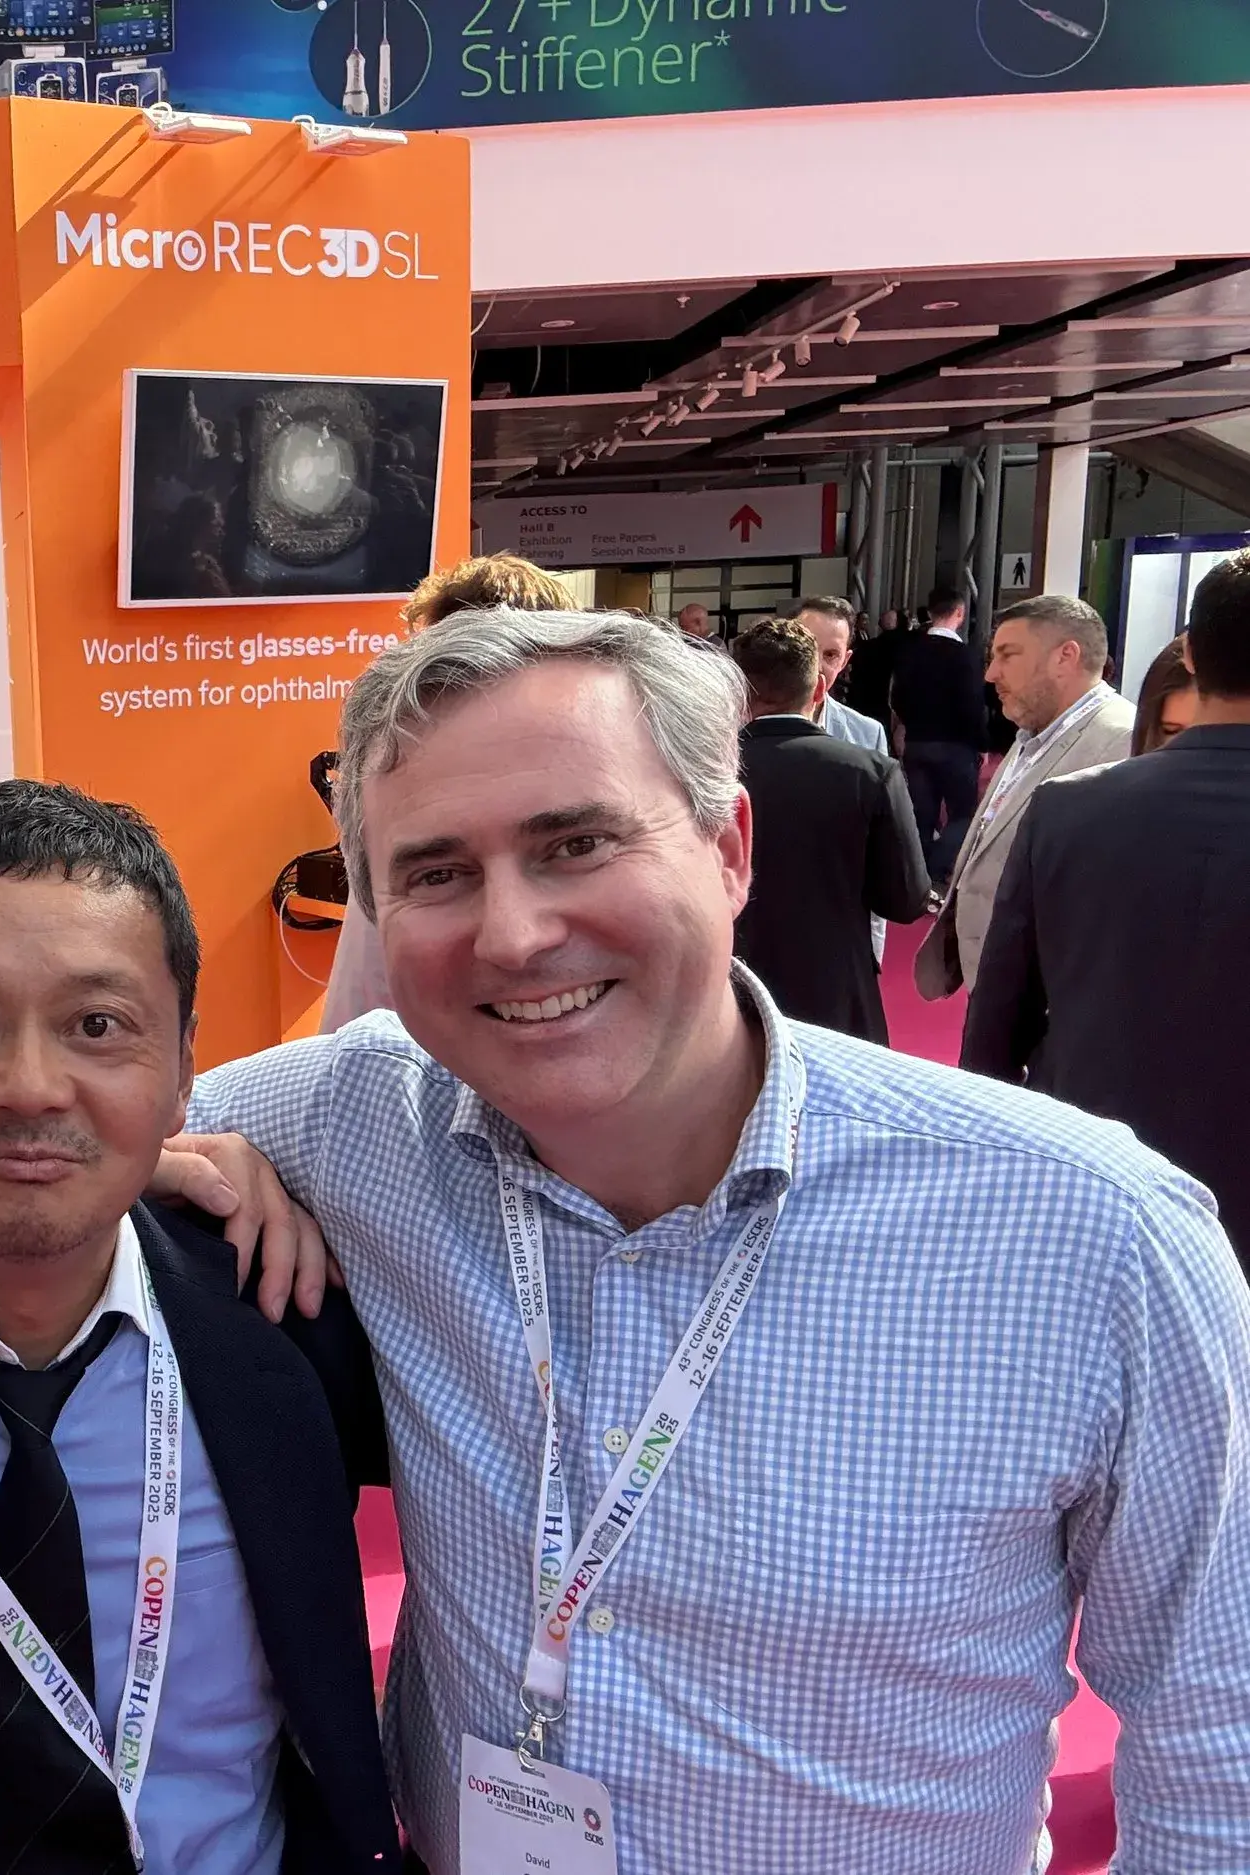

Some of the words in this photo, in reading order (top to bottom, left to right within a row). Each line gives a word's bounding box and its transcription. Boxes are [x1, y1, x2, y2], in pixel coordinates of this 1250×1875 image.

[519, 506, 567, 517] ACCESS
[570, 505, 587, 515] TO
[519, 535, 572, 547] Exhibition
[591, 533, 616, 544] Free
[619, 533, 657, 544] Papers
[591, 546, 633, 557] Session
[636, 545, 675, 556] Rooms
[183, 634, 234, 660] first
[239, 628, 399, 665] glasses-free
[100, 687, 192, 718] system
[198, 679, 235, 706] for
[504, 1193, 528, 1286] SEPTEMBER
[519, 1288, 535, 1328] 2025
[533, 1282, 544, 1317] ESCRS
[690, 1289, 725, 1351] CONGRESS
[720, 1277, 732, 1290] OF
[726, 1261, 741, 1279] THE
[742, 1214, 770, 1250] ESCRS
[688, 1342, 719, 1391] 12-16
[713, 1253, 763, 1345] SEPTEMBER
[151, 1339, 164, 1386] 12-16
[167, 1374, 179, 1437] CONGRESS
[149, 1389, 163, 1481] SEPTEMBER
[168, 1437, 176, 1449] OF
[168, 1450, 176, 1466] THE
[147, 1484, 162, 1524] 2025
[163, 1481, 176, 1517] ESCRS
[584, 1831, 604, 1846] ESCRS
[525, 1852, 550, 1868] David
